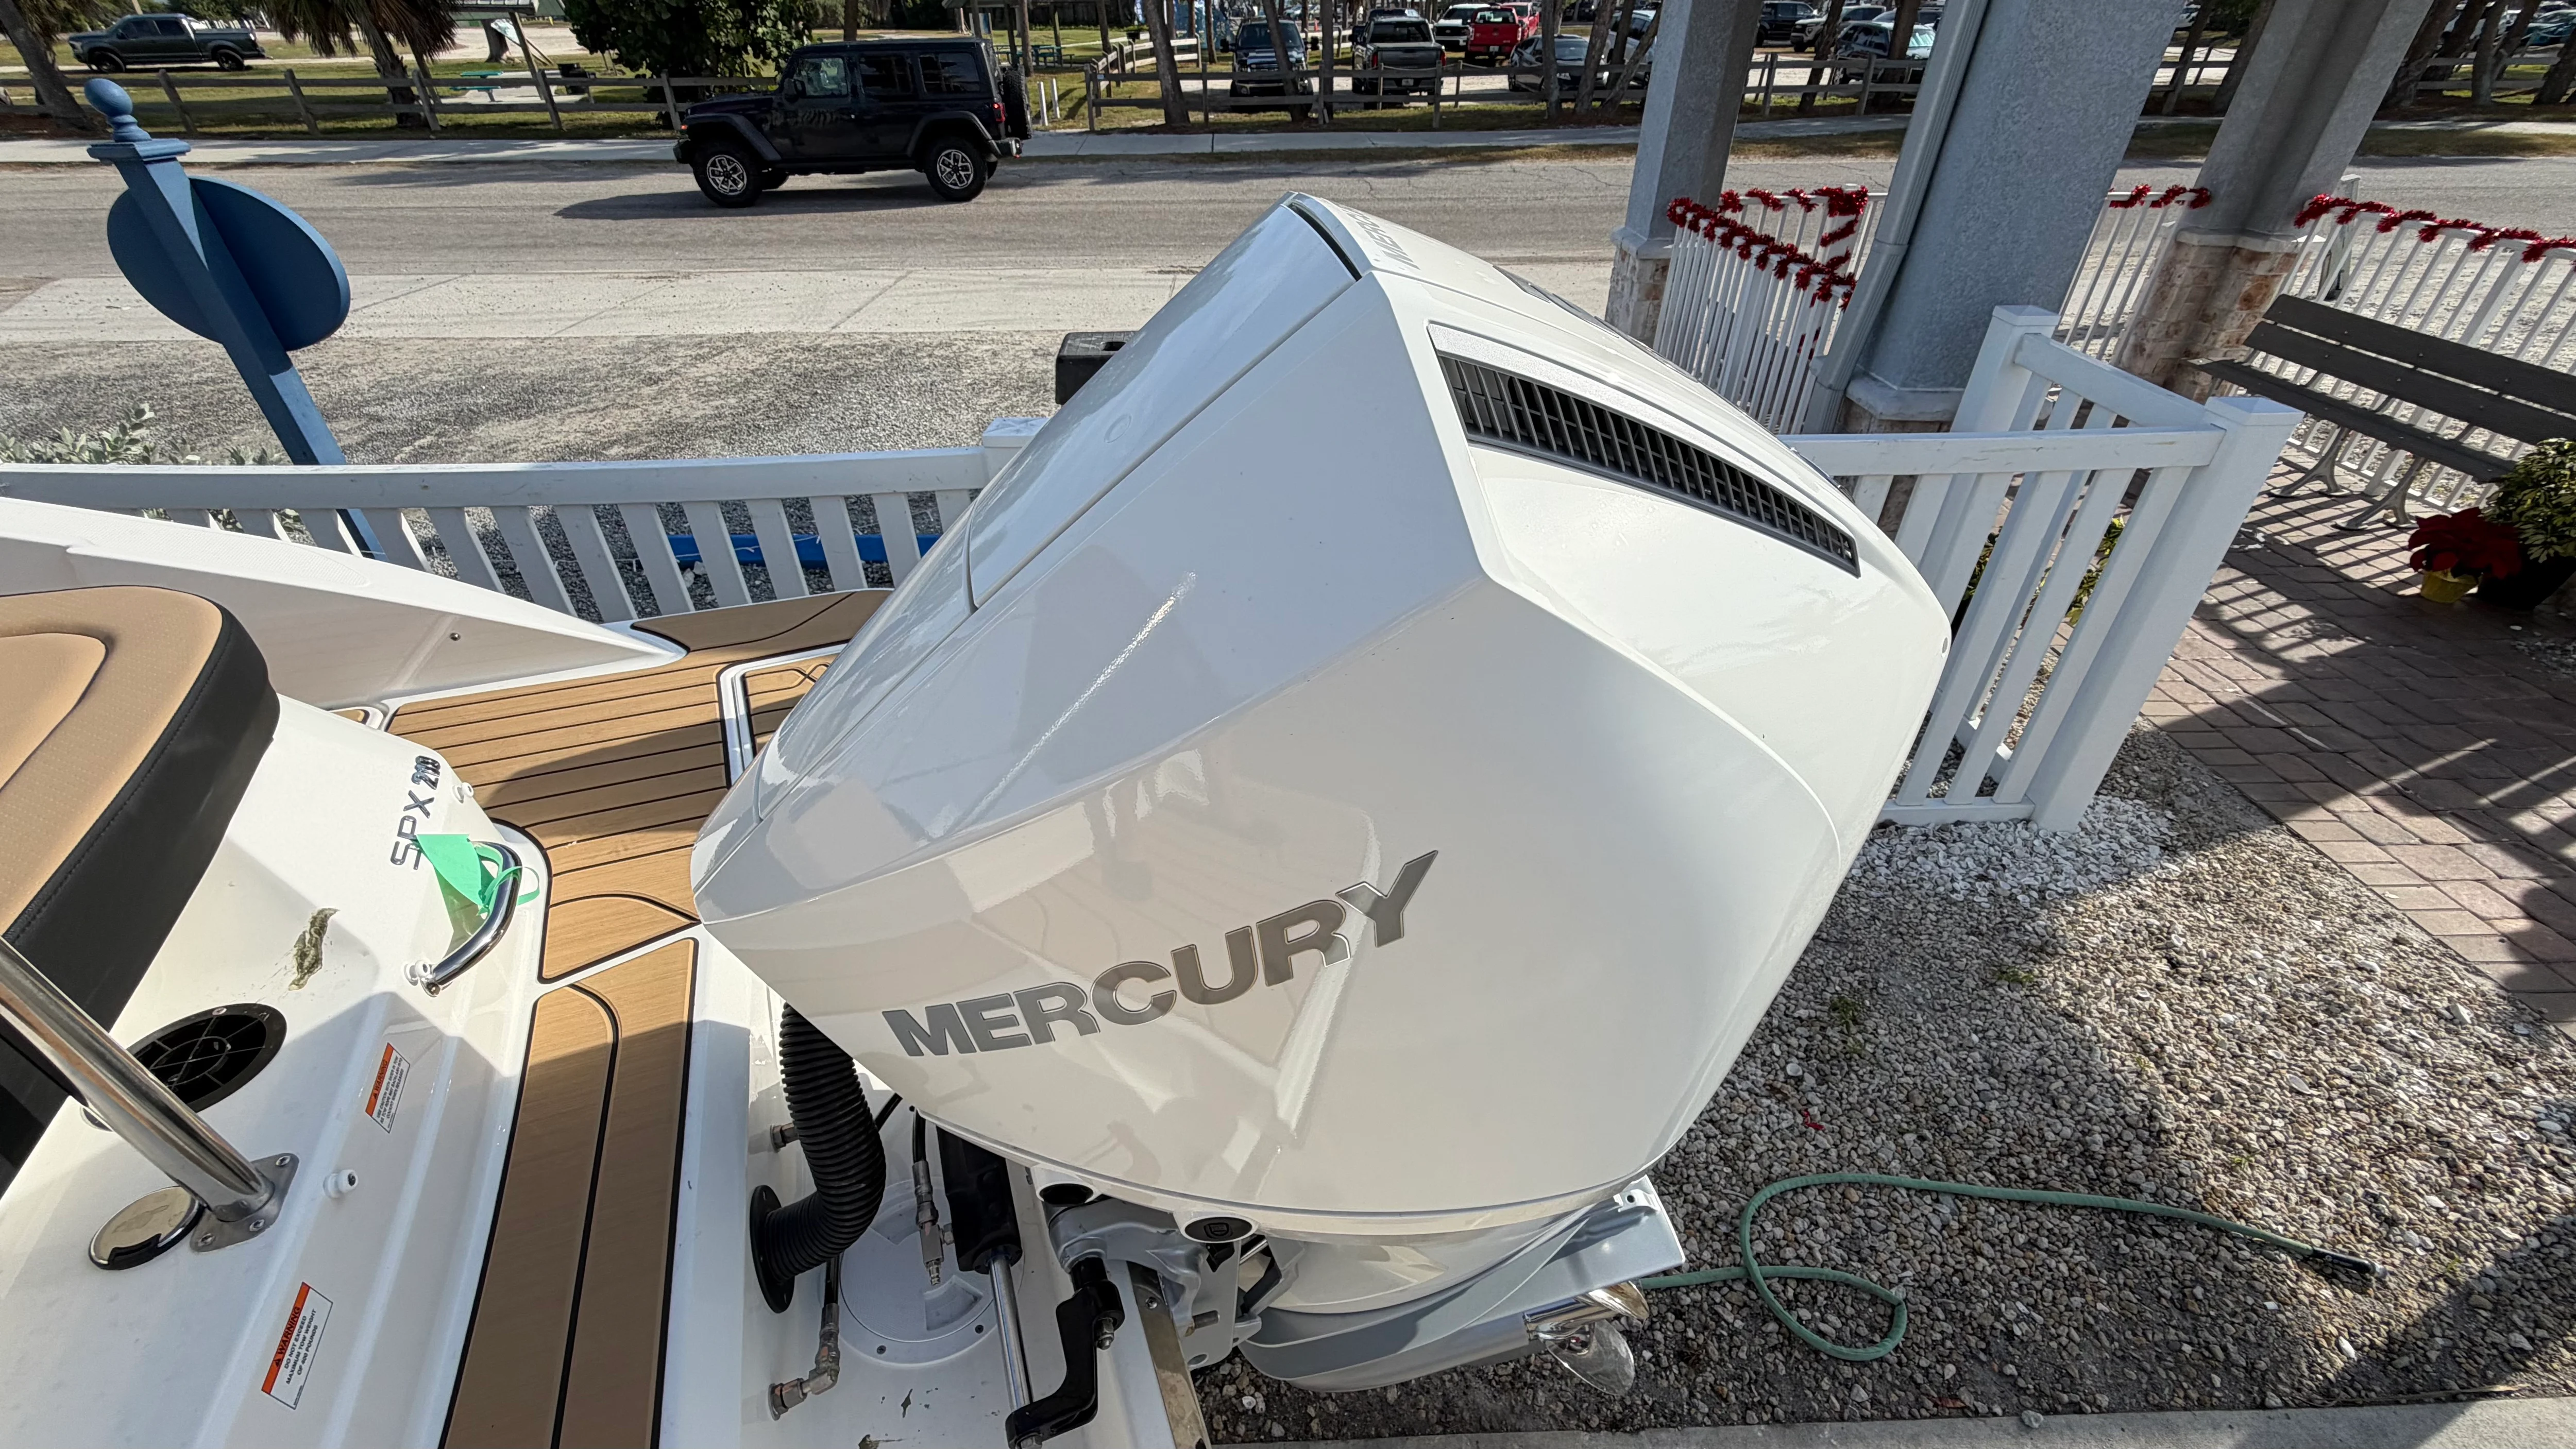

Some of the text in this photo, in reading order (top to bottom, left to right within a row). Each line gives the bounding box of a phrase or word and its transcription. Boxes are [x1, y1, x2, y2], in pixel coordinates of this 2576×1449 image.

[390, 755, 441, 871] SPX 210
[881, 849, 1439, 1058] MERCURY
[374, 1059, 387, 1091] WARNING
[278, 1306, 301, 1355] WARNING
[284, 1315, 307, 1369] DO NOT EXCEED
[286, 1351, 301, 1385] MAXIMUM
[298, 1334, 307, 1351] TOW
[304, 1308, 316, 1334] WEIGHT
[297, 1365, 303, 1375] OF
[306, 1324, 318, 1352] POUNDS
